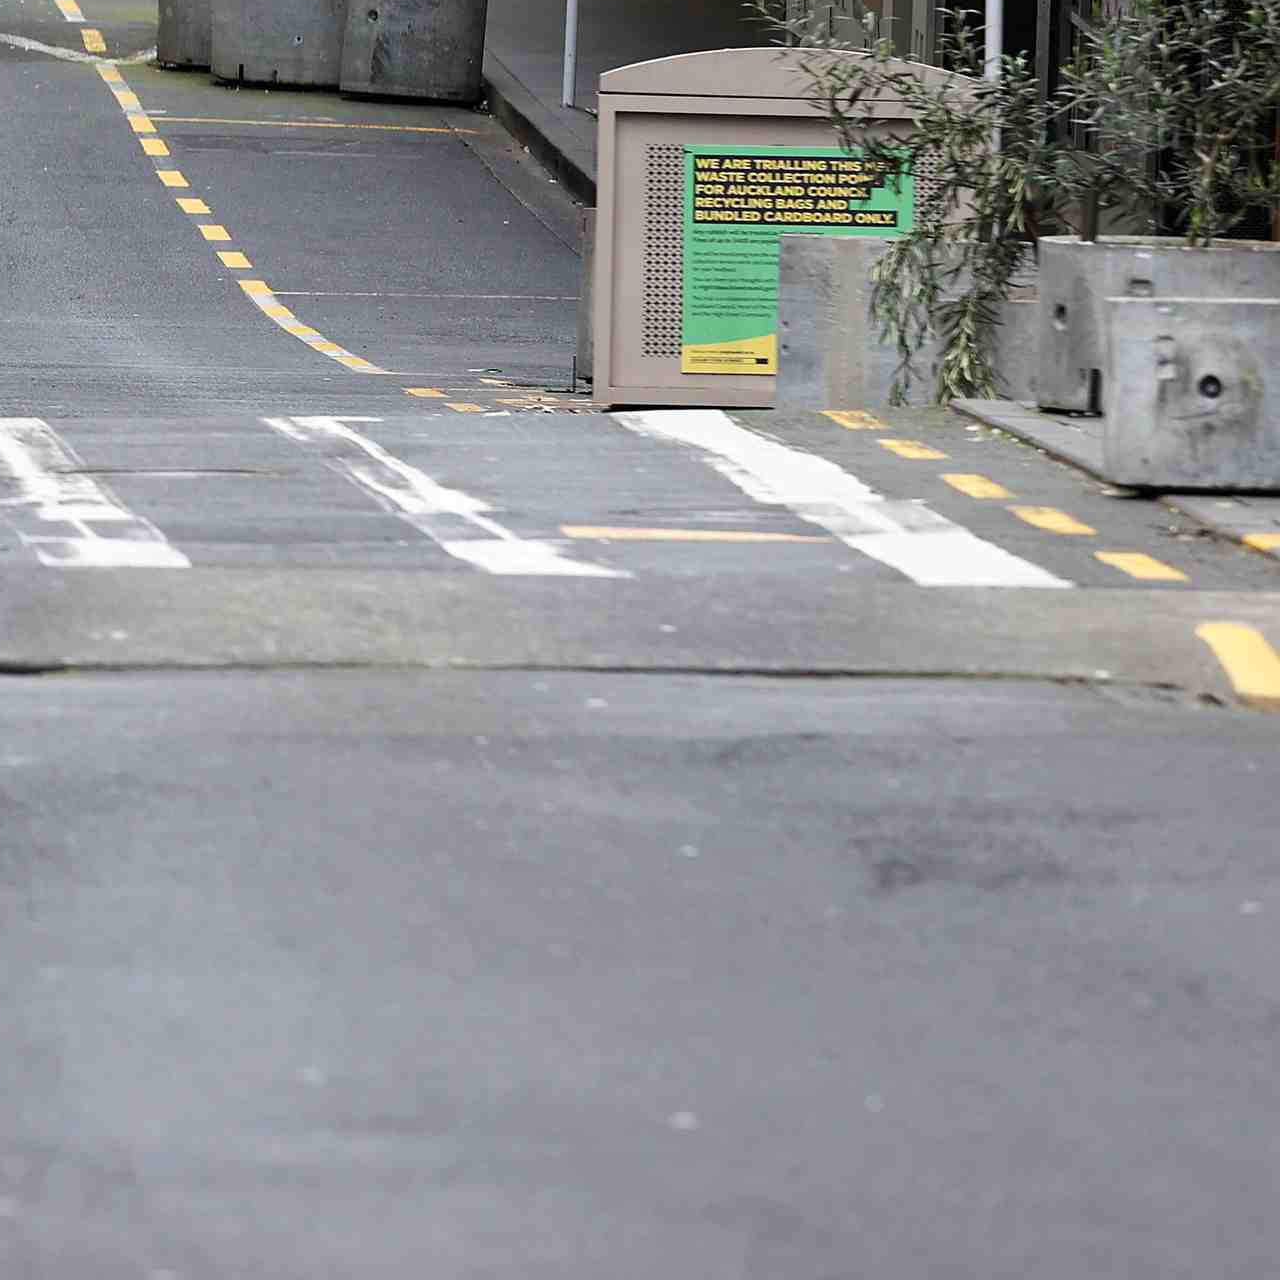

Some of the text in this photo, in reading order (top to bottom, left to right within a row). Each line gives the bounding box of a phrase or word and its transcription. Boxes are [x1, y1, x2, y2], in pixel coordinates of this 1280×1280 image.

[696, 158, 720, 170] WE
[721, 159, 752, 170] ARE
[755, 160, 825, 172] TRIALLING
[826, 161, 861, 172] THIS
[696, 171, 745, 183] WASTE
[747, 172, 836, 184] COLLECTION
[696, 184, 724, 195] FOR
[727, 185, 805, 197] AUCKLAND
[696, 197, 848, 210] RECYCLING BAGS AND
[695, 210, 895, 224] BUNDLED CARDBOARD ONLY.
